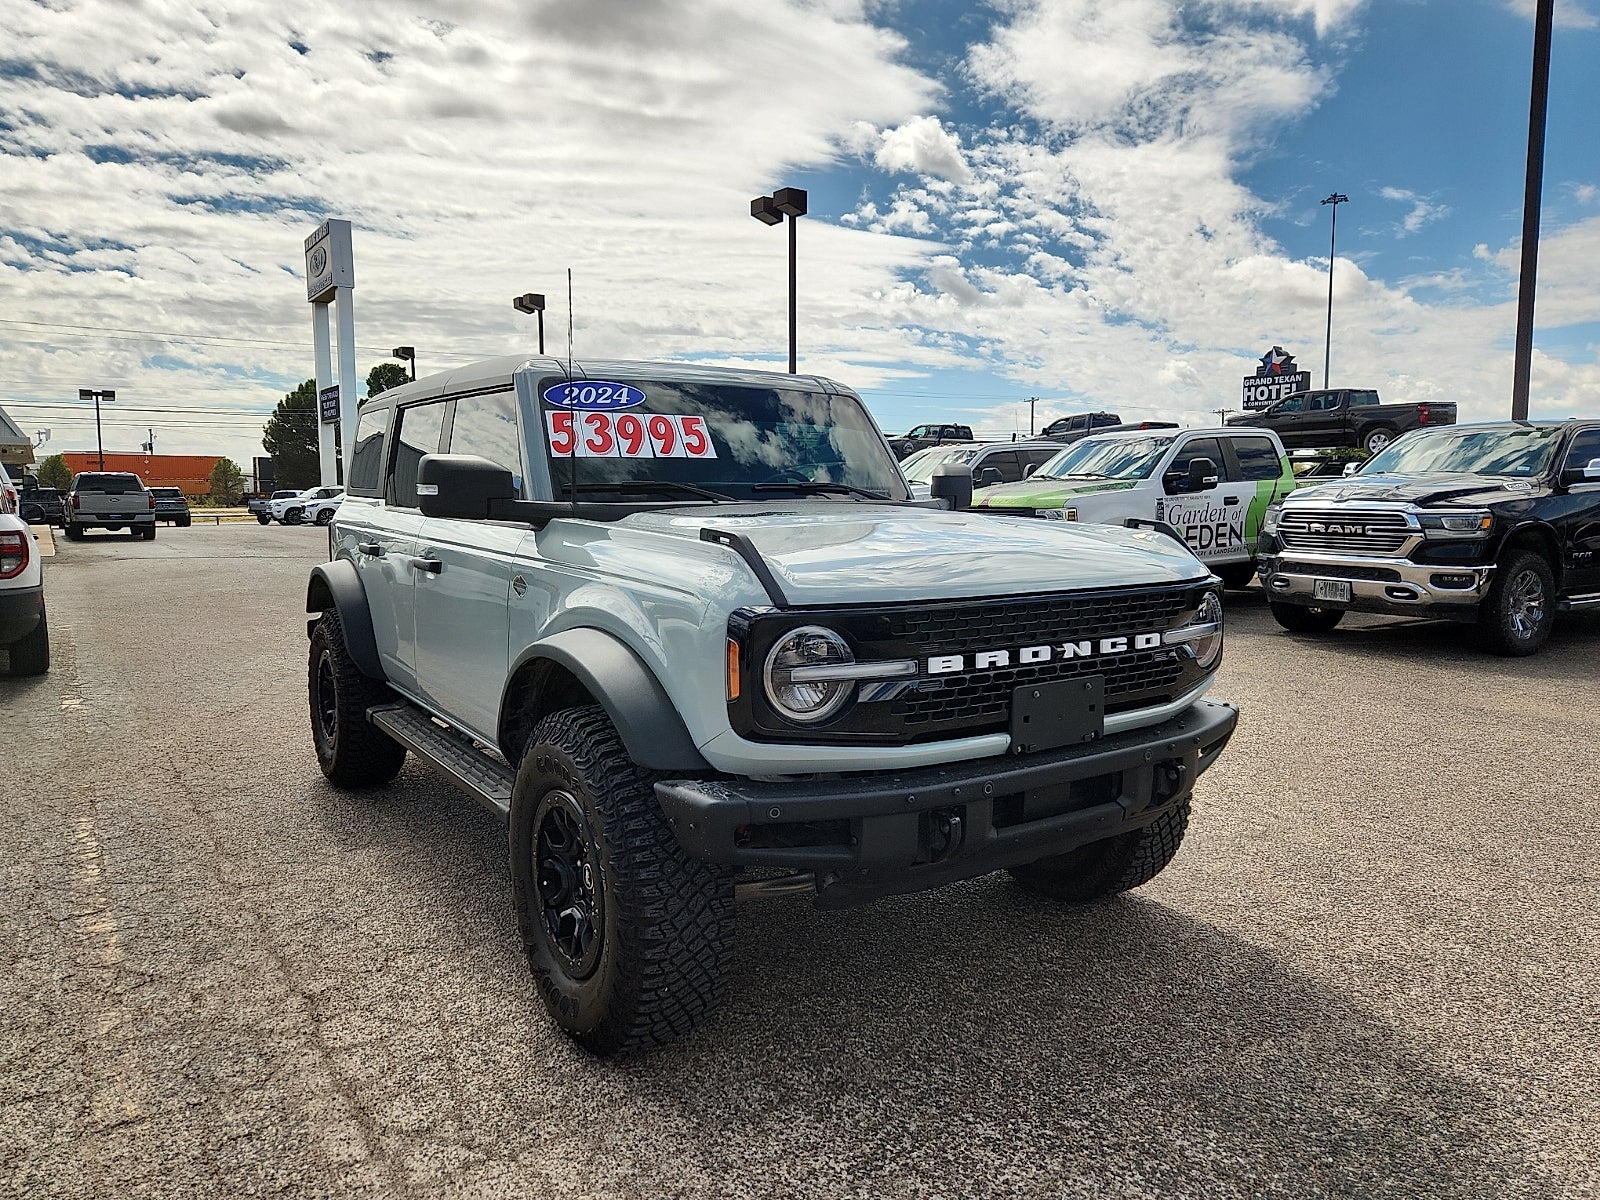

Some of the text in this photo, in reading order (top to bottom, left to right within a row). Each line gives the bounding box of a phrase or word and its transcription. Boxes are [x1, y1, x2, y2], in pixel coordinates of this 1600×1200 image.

[1244, 374, 1302, 387] GRAND TEXAN
[562, 386, 630, 405] 2024
[1248, 399, 1279, 407] CONVENTIO
[551, 412, 708, 456] 53995
[1168, 502, 1226, 526] Garden
[1231, 506, 1244, 525] of
[1185, 521, 1244, 550] EDEN
[1310, 522, 1363, 534] RAM
[928, 632, 1161, 674] BRONCO
